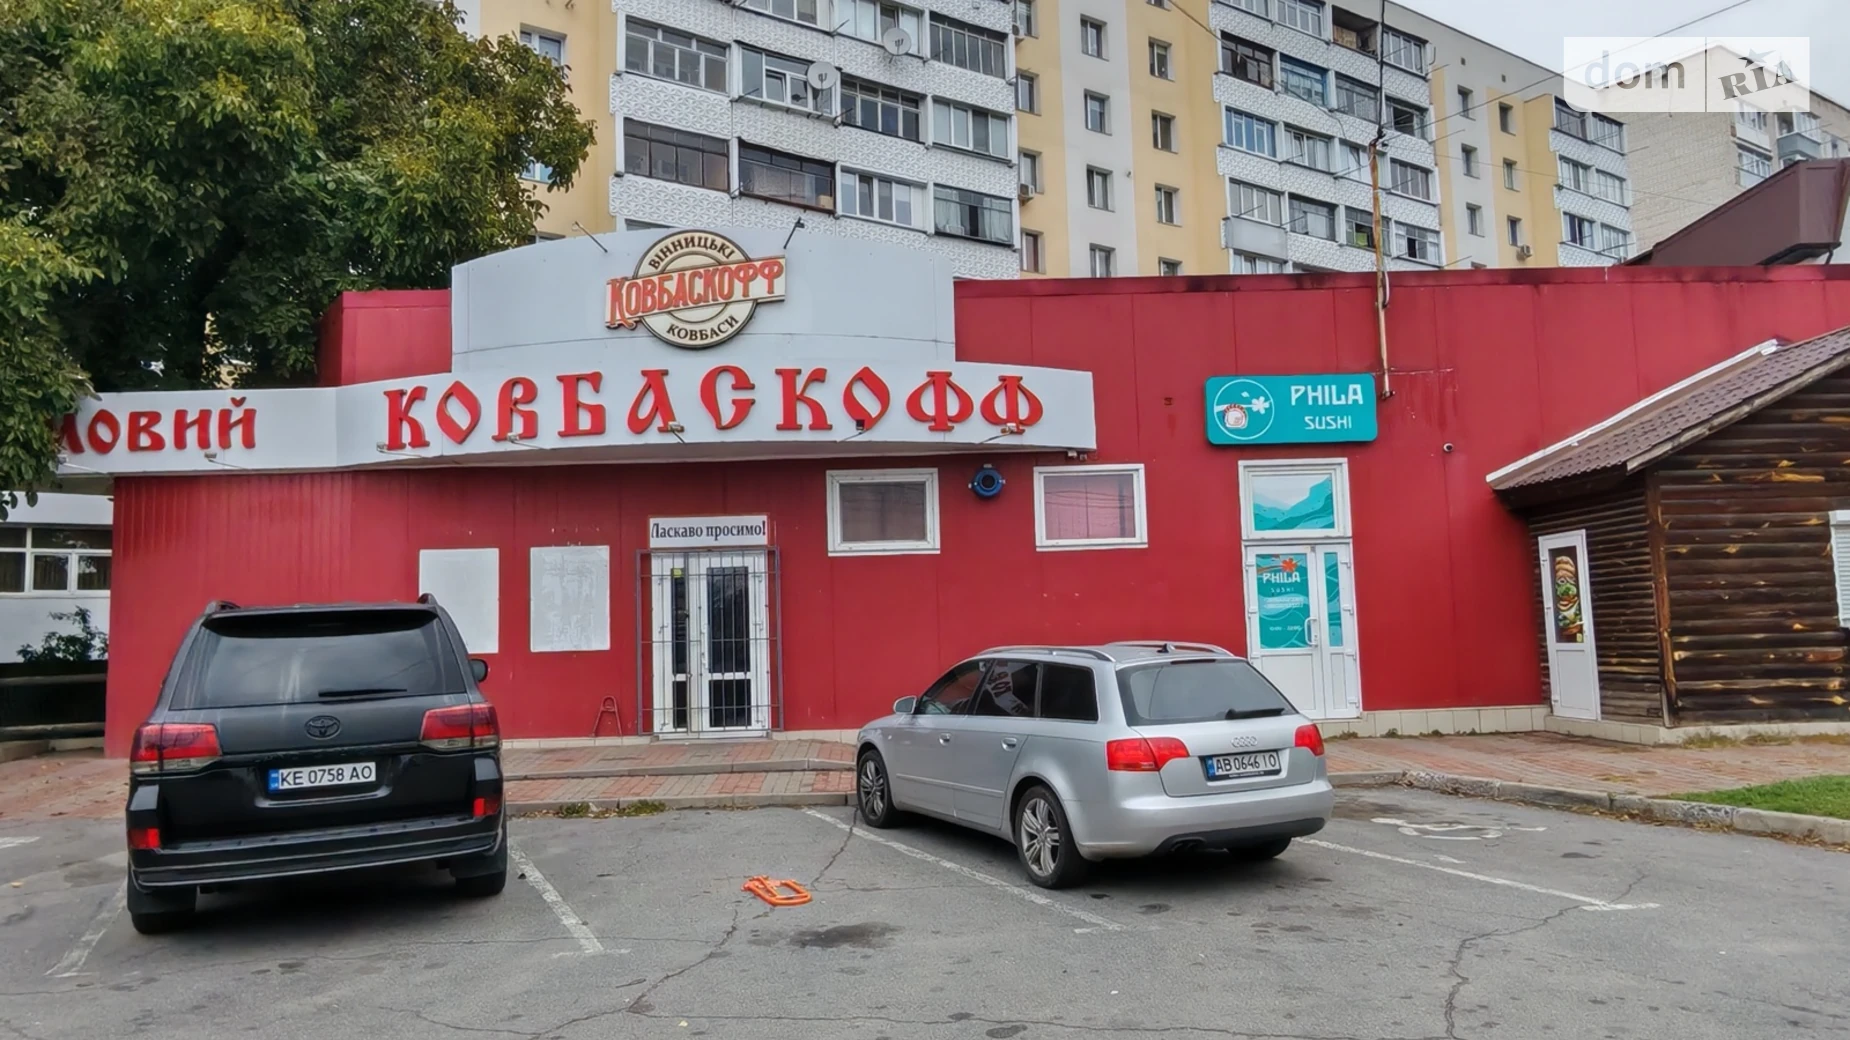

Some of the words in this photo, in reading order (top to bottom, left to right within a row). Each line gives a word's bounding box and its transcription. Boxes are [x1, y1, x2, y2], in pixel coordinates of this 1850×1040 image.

[648, 235, 735, 270] ВІННИЦЬКІ
[608, 259, 784, 330] КОВБАСКОФФ
[666, 315, 739, 342] КОВБАСИ
[1290, 383, 1364, 407] PHILA
[384, 365, 1044, 450] КОВБАСКОФФ
[1304, 415, 1352, 430] SUSHI
[651, 522, 703, 539] Ласкаво
[706, 519, 766, 541] просимо!
[1263, 571, 1301, 584] PHILA
[1216, 757, 1232, 773] AB
[1233, 755, 1260, 771] 0646
[280, 770, 304, 787] KE
[308, 767, 344, 784] 0758
[349, 765, 372, 780] AO
